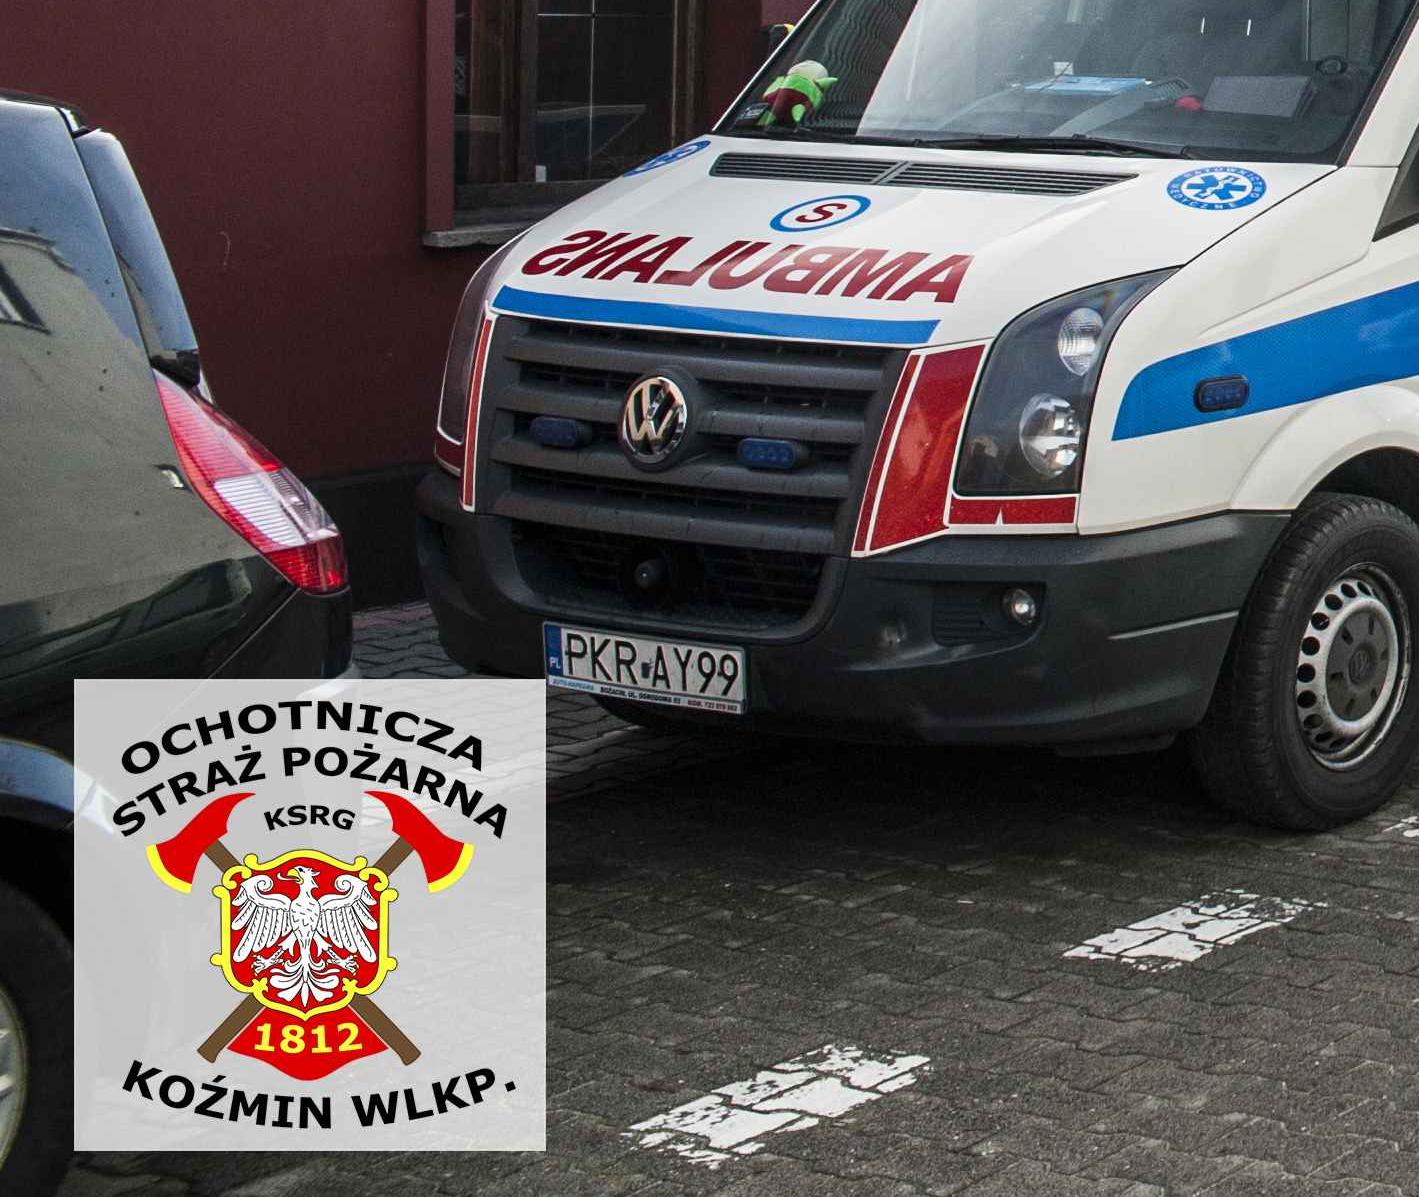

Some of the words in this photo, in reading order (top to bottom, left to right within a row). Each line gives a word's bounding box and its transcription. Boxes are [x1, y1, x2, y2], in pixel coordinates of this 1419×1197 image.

[795, 202, 847, 224] S
[549, 656, 561, 670] PL
[564, 632, 639, 685] PKR
[651, 645, 739, 696] AY99
